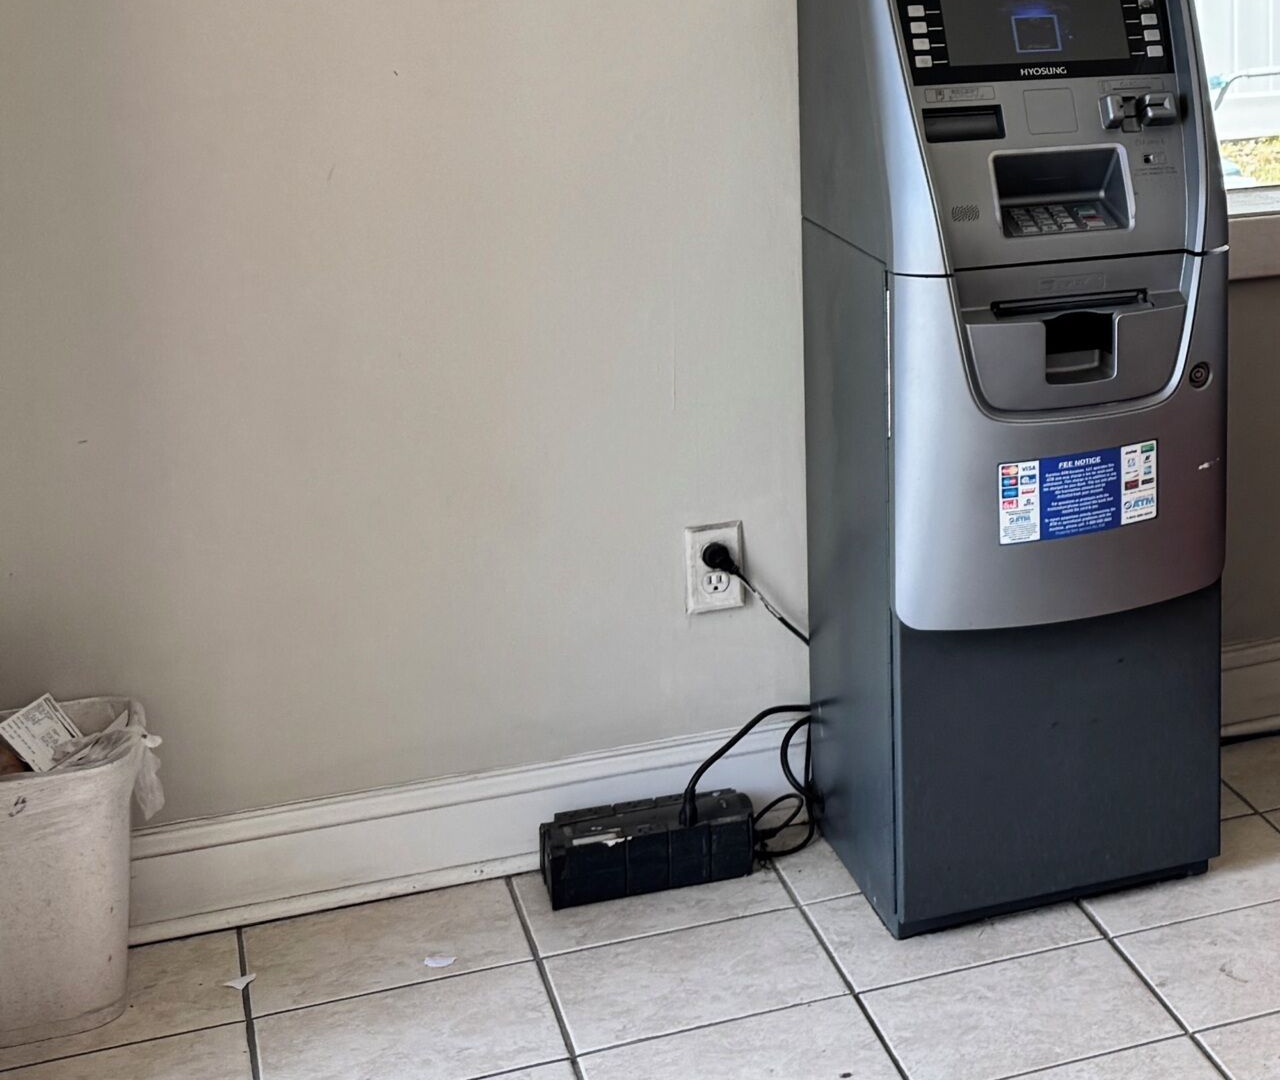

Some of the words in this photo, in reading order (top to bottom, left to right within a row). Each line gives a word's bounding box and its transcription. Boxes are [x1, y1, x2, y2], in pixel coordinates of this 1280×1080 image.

[1019, 66, 1068, 77] HYOSUNG
[1058, 459, 1074, 469] FEE
[1074, 455, 1102, 467] NOTICE
